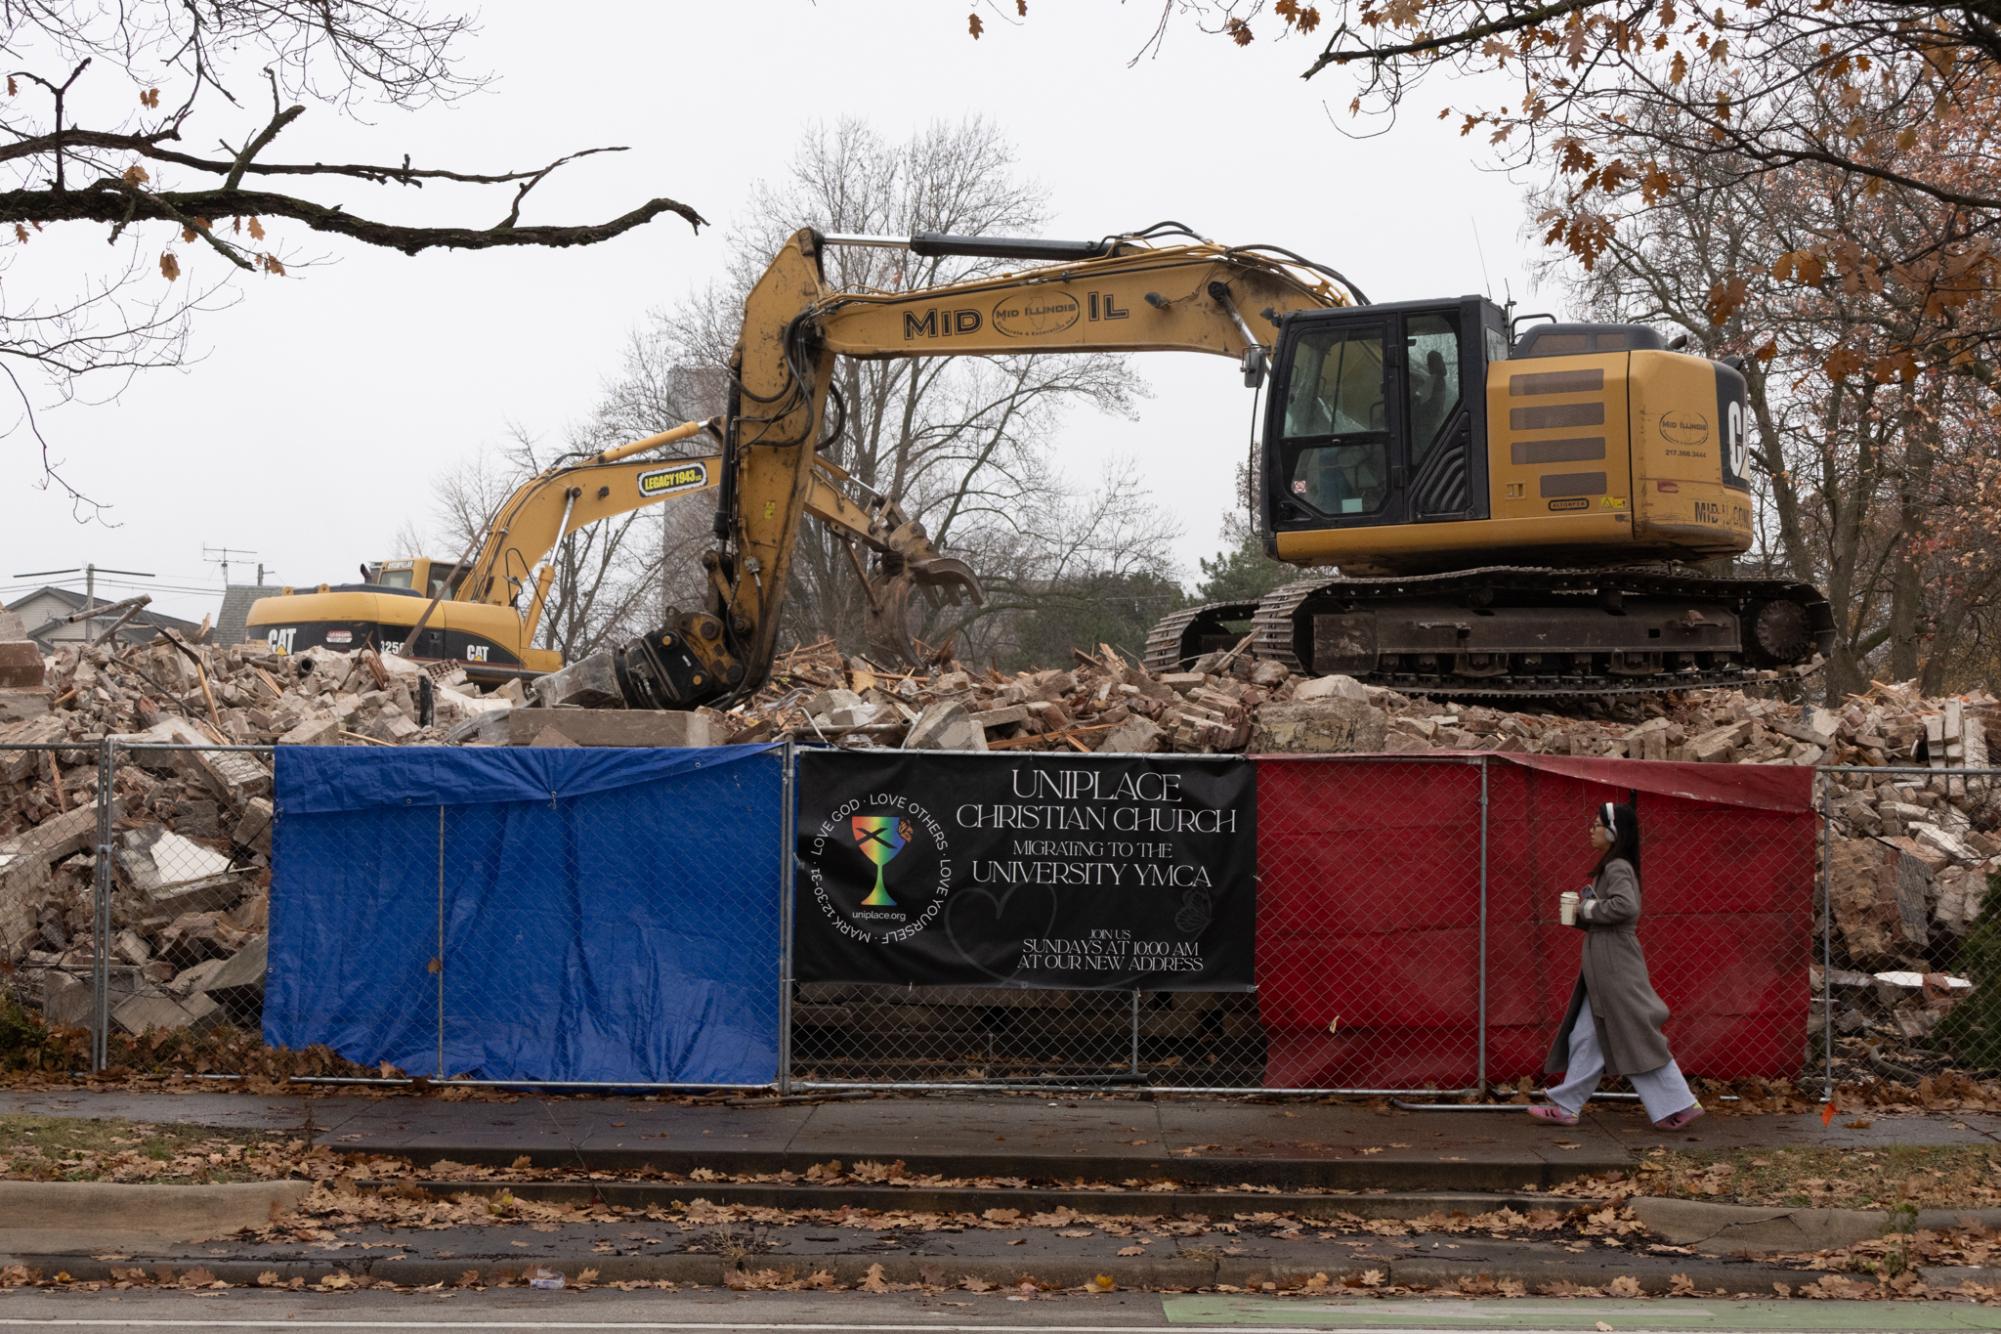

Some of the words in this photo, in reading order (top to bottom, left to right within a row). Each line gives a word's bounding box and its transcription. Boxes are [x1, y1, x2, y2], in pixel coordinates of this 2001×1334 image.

[1088, 291, 1129, 321] IL
[903, 307, 983, 340] MID
[645, 473, 675, 491] LEGACY
[675, 469, 696, 485] 1943
[268, 628, 297, 656] CAT
[467, 644, 489, 662] CAT
[1012, 769, 1182, 802] UNIPLACE
[831, 799, 860, 822] GOD
[870, 793, 907, 808] LOVE
[908, 803, 948, 851] OTHERS
[956, 804, 1106, 831] CHRISTIAN
[1113, 807, 1236, 833] CHURCH
[811, 820, 835, 856] LOVE
[1013, 840, 1103, 857] MIGRATING
[1108, 842, 1134, 857] TO
[1137, 843, 1173, 858] THE
[936, 859, 951, 897] LOVE
[972, 860, 1127, 886] UNIVERSITY
[1133, 863, 1213, 887] YMCA
[811, 868, 836, 918] 12:30-31
[832, 916, 871, 943] MARK
[852, 911, 906, 922] uniplace.org
[881, 899, 944, 944] YOURSELF
[1022, 939, 1102, 954] SUNDAYS
[1106, 941, 1131, 955] AT
[1134, 941, 1170, 956] 10:00
[1172, 942, 1199, 956] AM
[1089, 929, 1113, 939] JOIN
[1115, 929, 1132, 939] US
[1017, 954, 1042, 969] AT
[1044, 954, 1082, 970] OUR
[1085, 956, 1125, 970] NEW
[1128, 957, 1204, 971] ADDRESS
